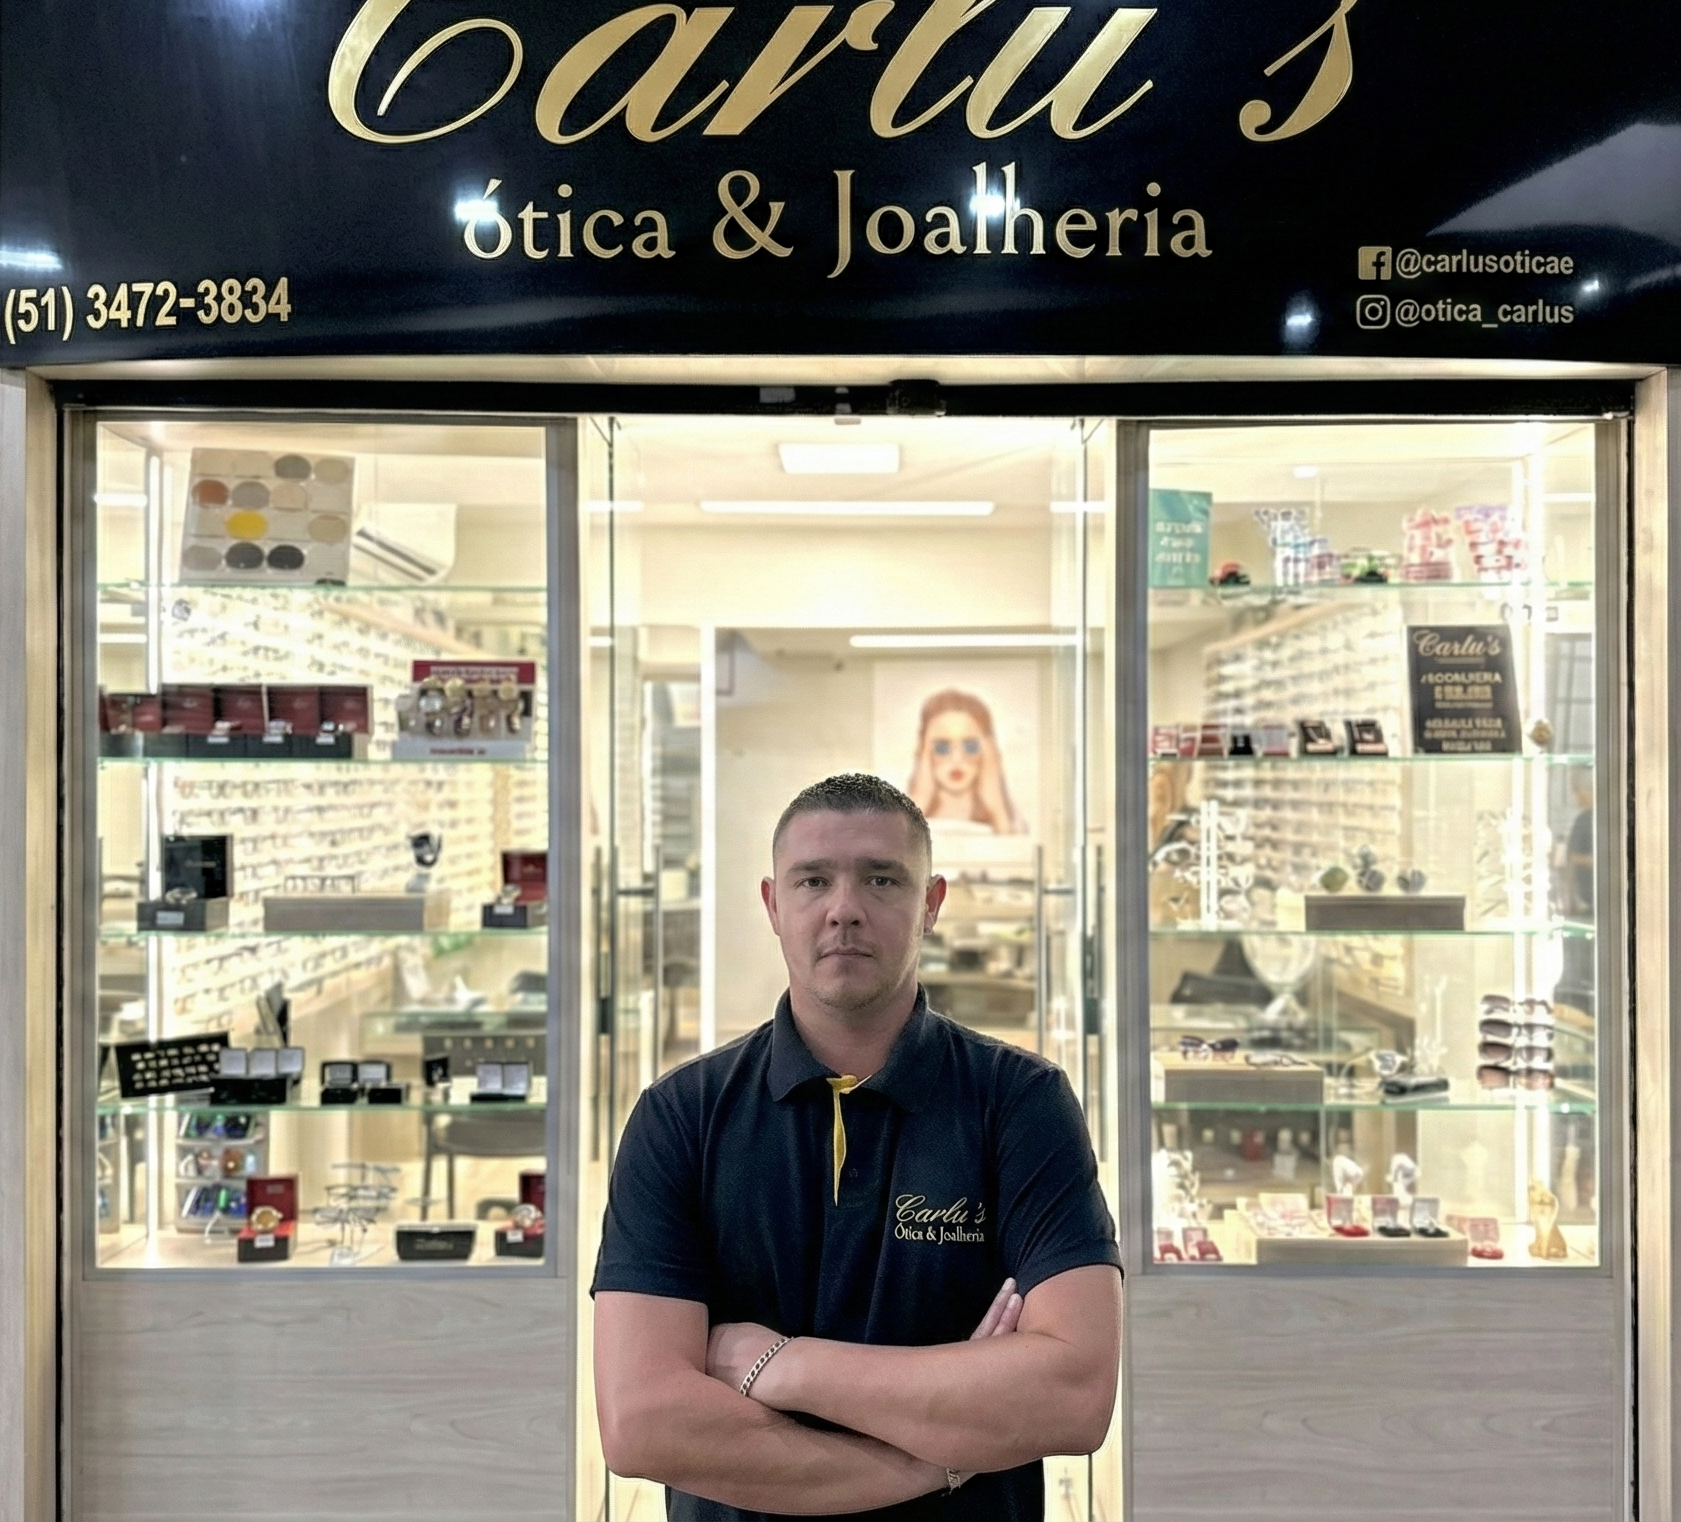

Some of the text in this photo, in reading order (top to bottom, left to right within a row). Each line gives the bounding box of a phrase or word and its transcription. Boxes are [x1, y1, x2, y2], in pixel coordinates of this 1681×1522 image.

[329, 0, 1356, 143] Carlus
[712, 169, 794, 259] &
[826, 161, 1213, 279] Joalheria
[1396, 248, 1574, 279] @carlusoticae
[4, 276, 292, 345] (51) 3472-3834
[1395, 299, 1574, 328] @otica_carlus
[1413, 629, 1501, 656] Carlu's
[895, 1194, 987, 1224] Carlu's
[926, 1226, 937, 1241] &
